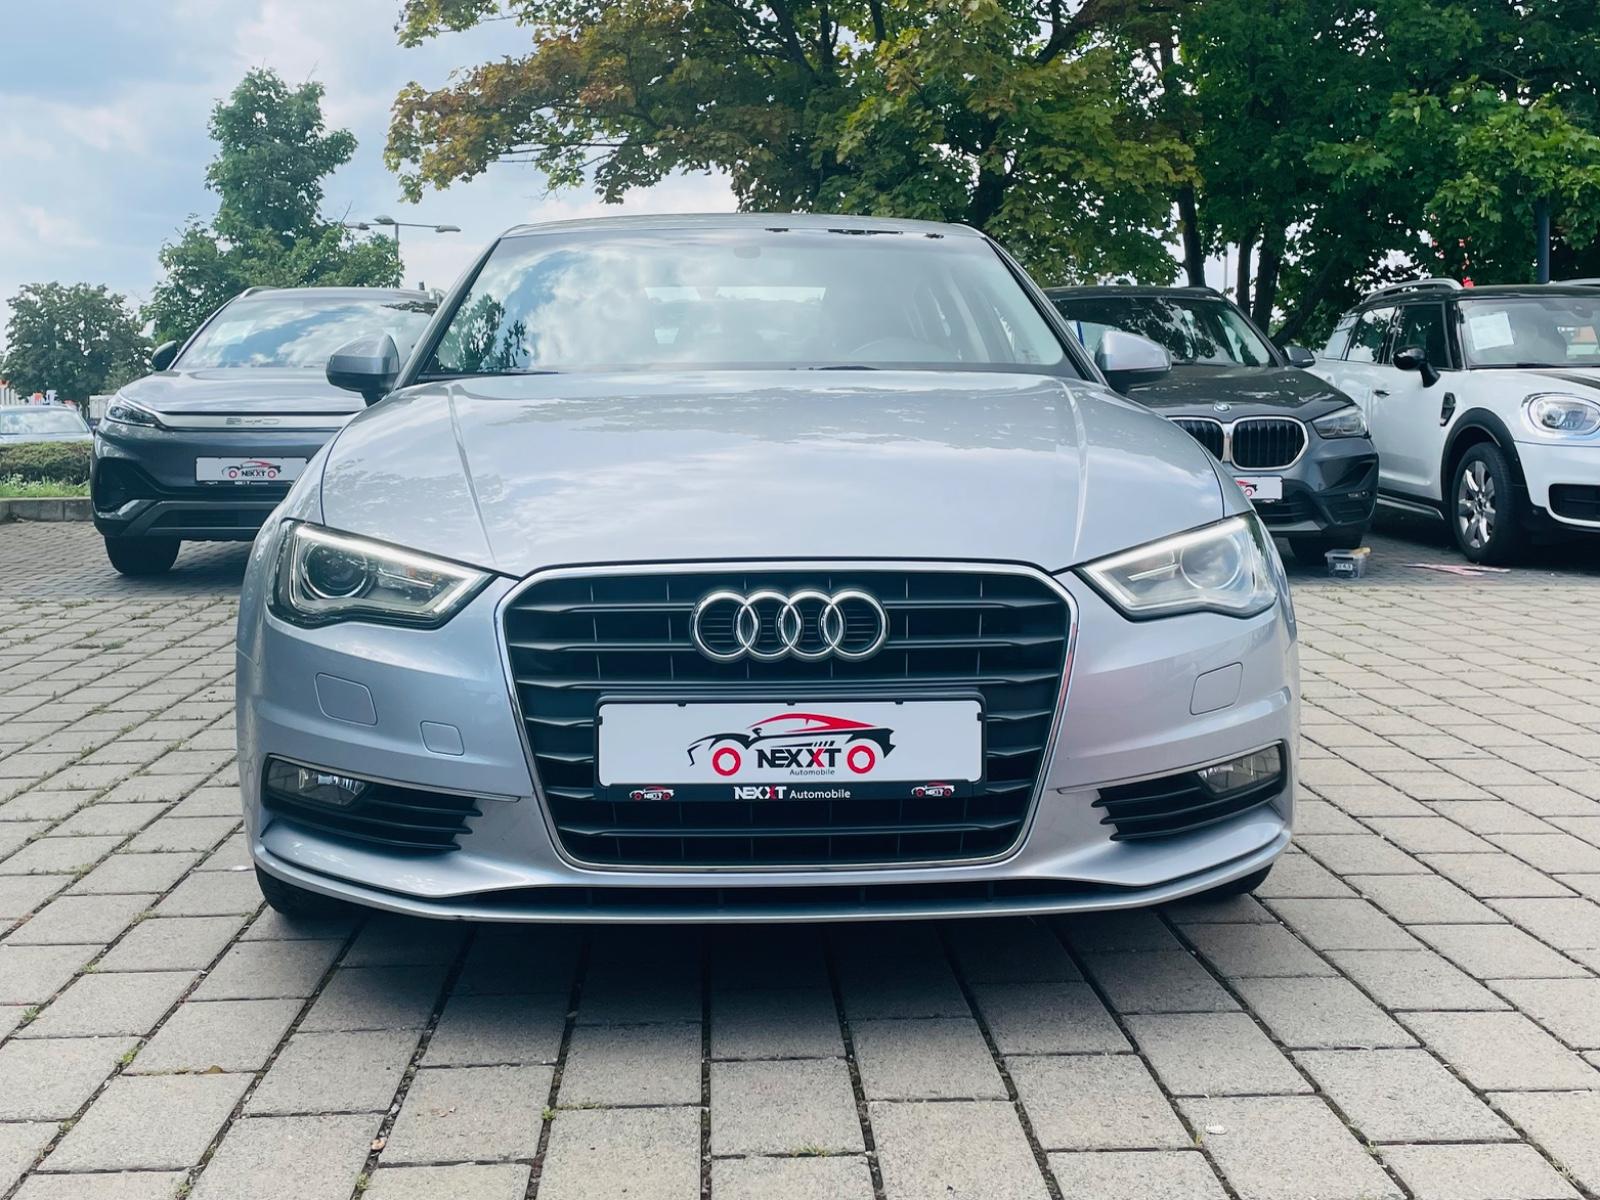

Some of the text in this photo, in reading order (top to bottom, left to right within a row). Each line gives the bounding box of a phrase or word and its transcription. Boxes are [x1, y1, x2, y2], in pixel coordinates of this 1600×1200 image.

[755, 748, 842, 769] NEXXT
[733, 785, 851, 800] NEXXT Automobile
